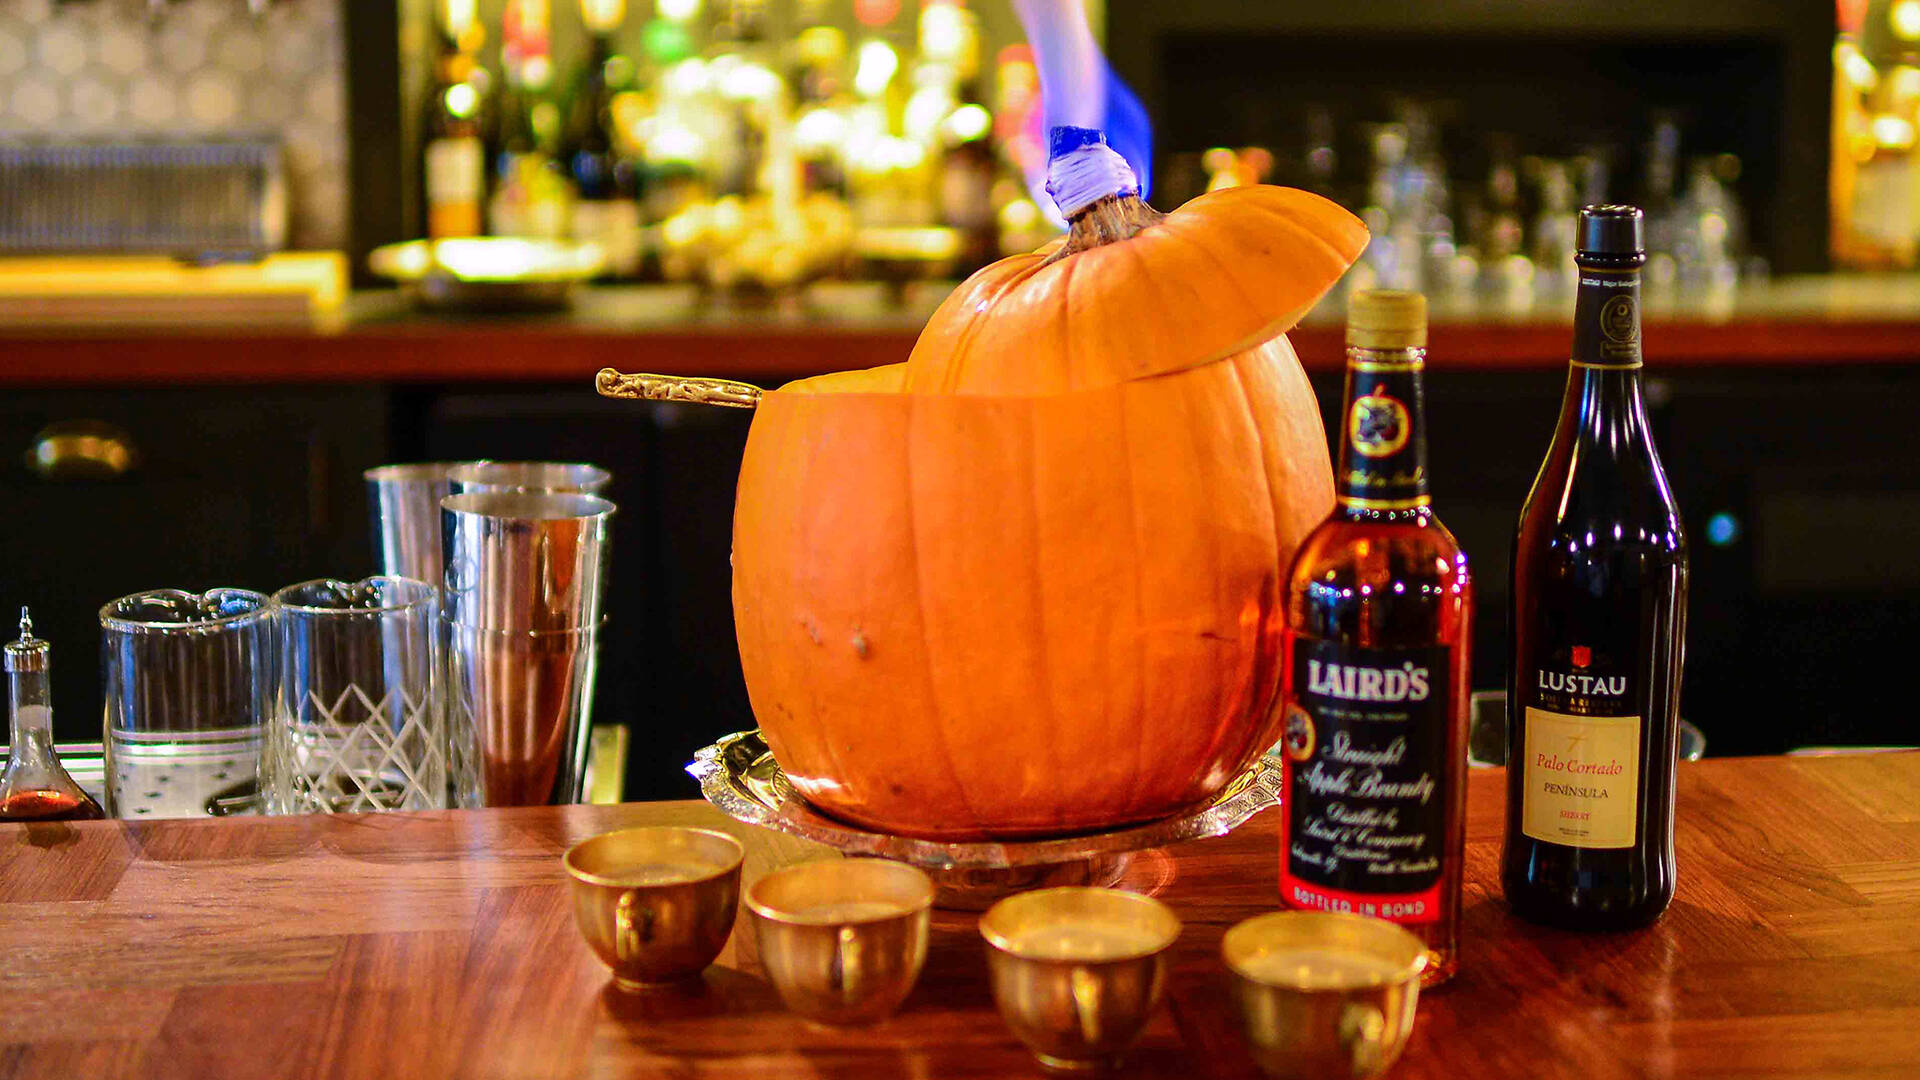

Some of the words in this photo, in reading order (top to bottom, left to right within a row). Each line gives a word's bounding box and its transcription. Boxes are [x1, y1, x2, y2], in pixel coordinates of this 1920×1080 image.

[1308, 659, 1430, 701] LAIRD'S
[1539, 669, 1626, 695] LUSTAU
[1536, 753, 1565, 773] Palo
[1567, 759, 1623, 776] Cortado
[1294, 886, 1351, 914] BOTTLED
[1382, 901, 1425, 917] BOND
